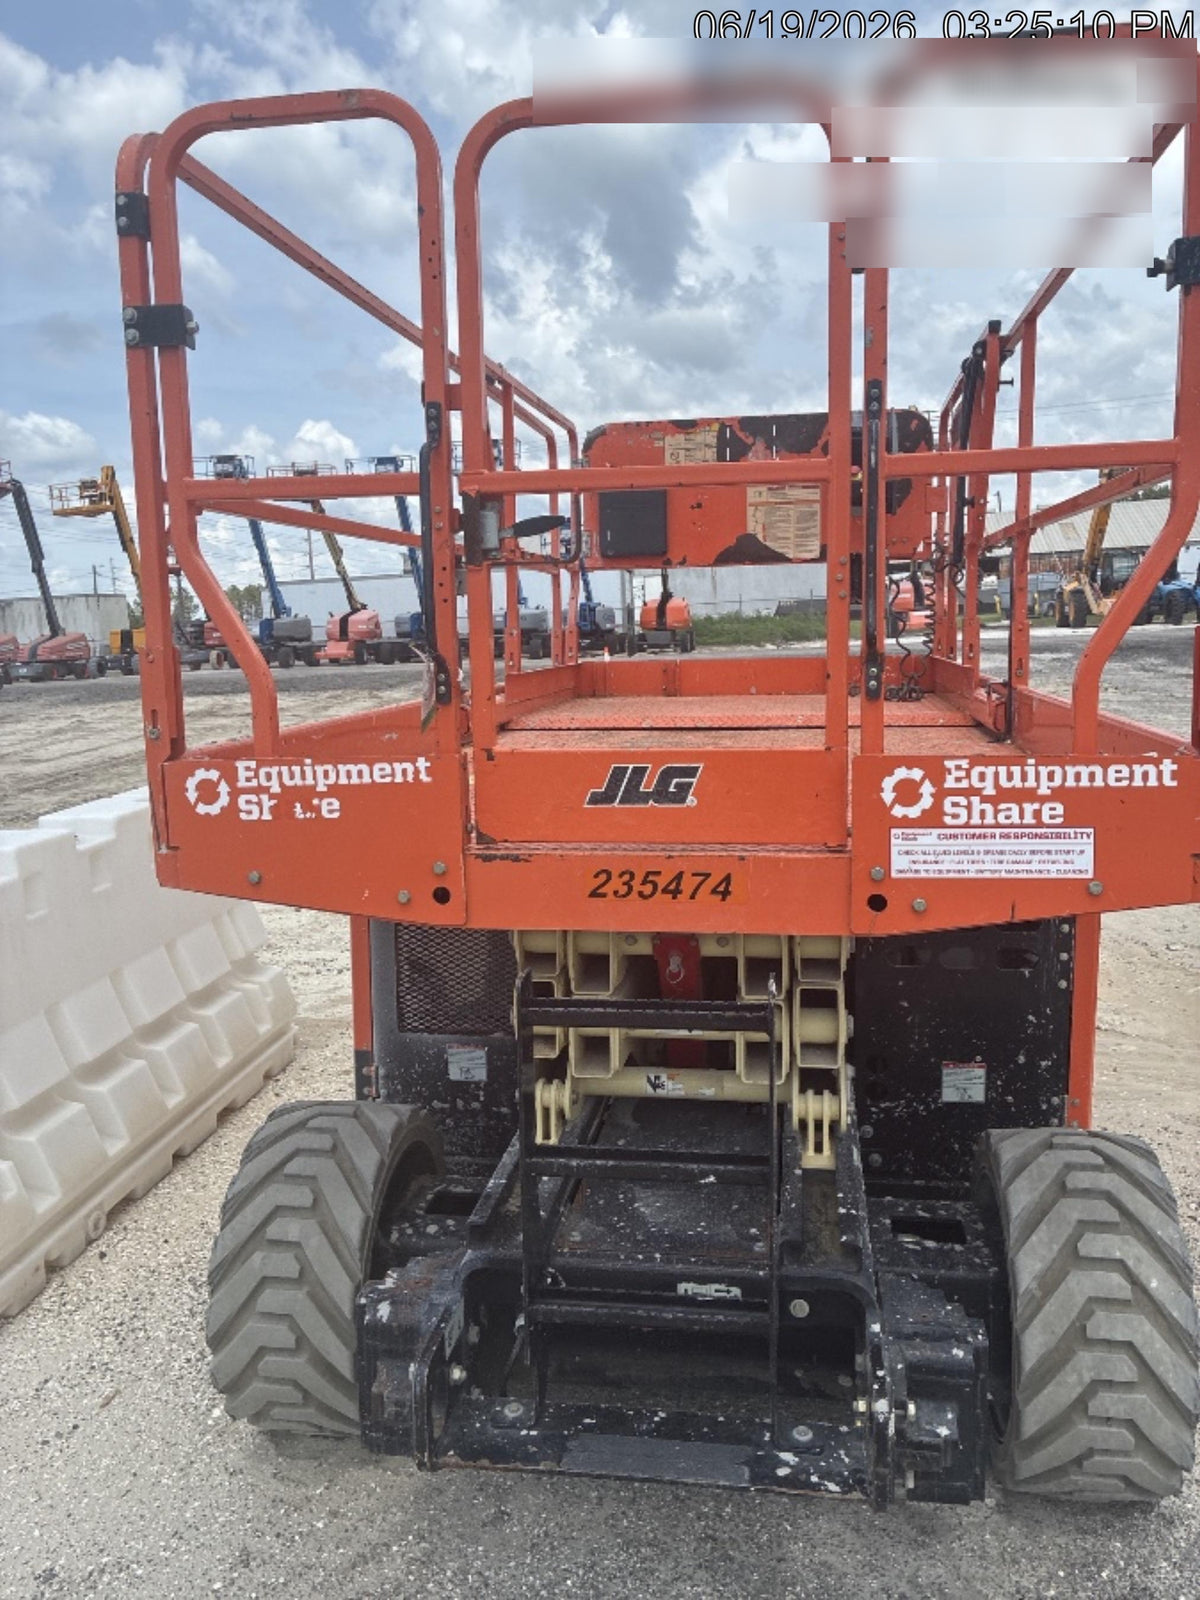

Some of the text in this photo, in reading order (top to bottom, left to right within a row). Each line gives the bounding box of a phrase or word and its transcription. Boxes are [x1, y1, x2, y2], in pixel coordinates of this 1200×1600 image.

[235, 757, 432, 793] Equipment
[583, 763, 704, 808] JLG
[943, 758, 1178, 795] Equipment
[942, 796, 1064, 825] Share
[937, 831, 1093, 841] CUSTOMER RESPONSIBILITY
[587, 868, 732, 901] 235474
